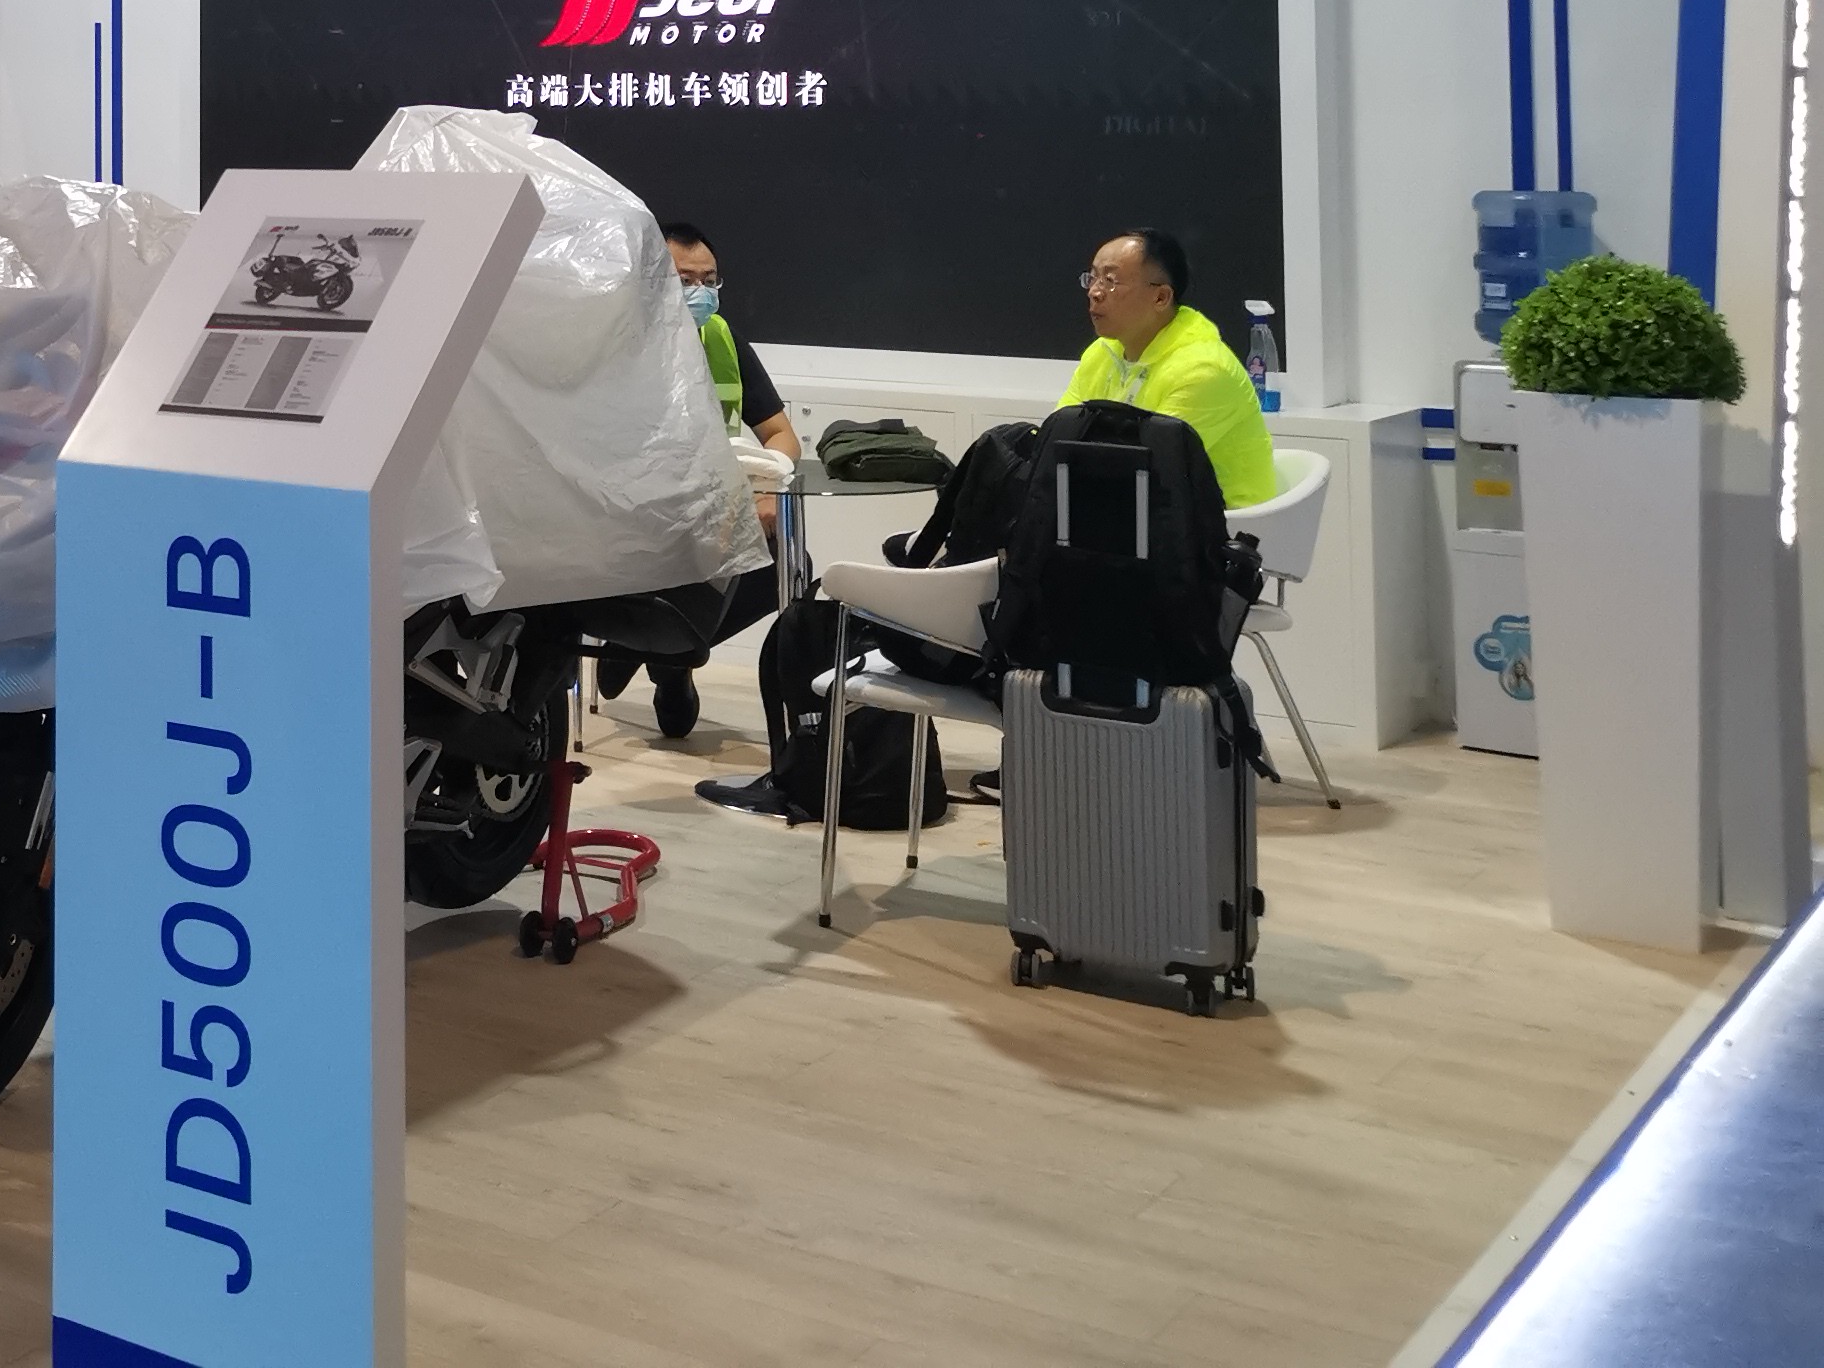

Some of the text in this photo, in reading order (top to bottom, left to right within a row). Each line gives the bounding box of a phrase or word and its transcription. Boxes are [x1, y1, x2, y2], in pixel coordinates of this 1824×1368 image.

[629, 23, 766, 46] MOTOR
[506, 70, 829, 108] 高端大排机车领创者
[160, 535, 253, 1295] JD500J-B
